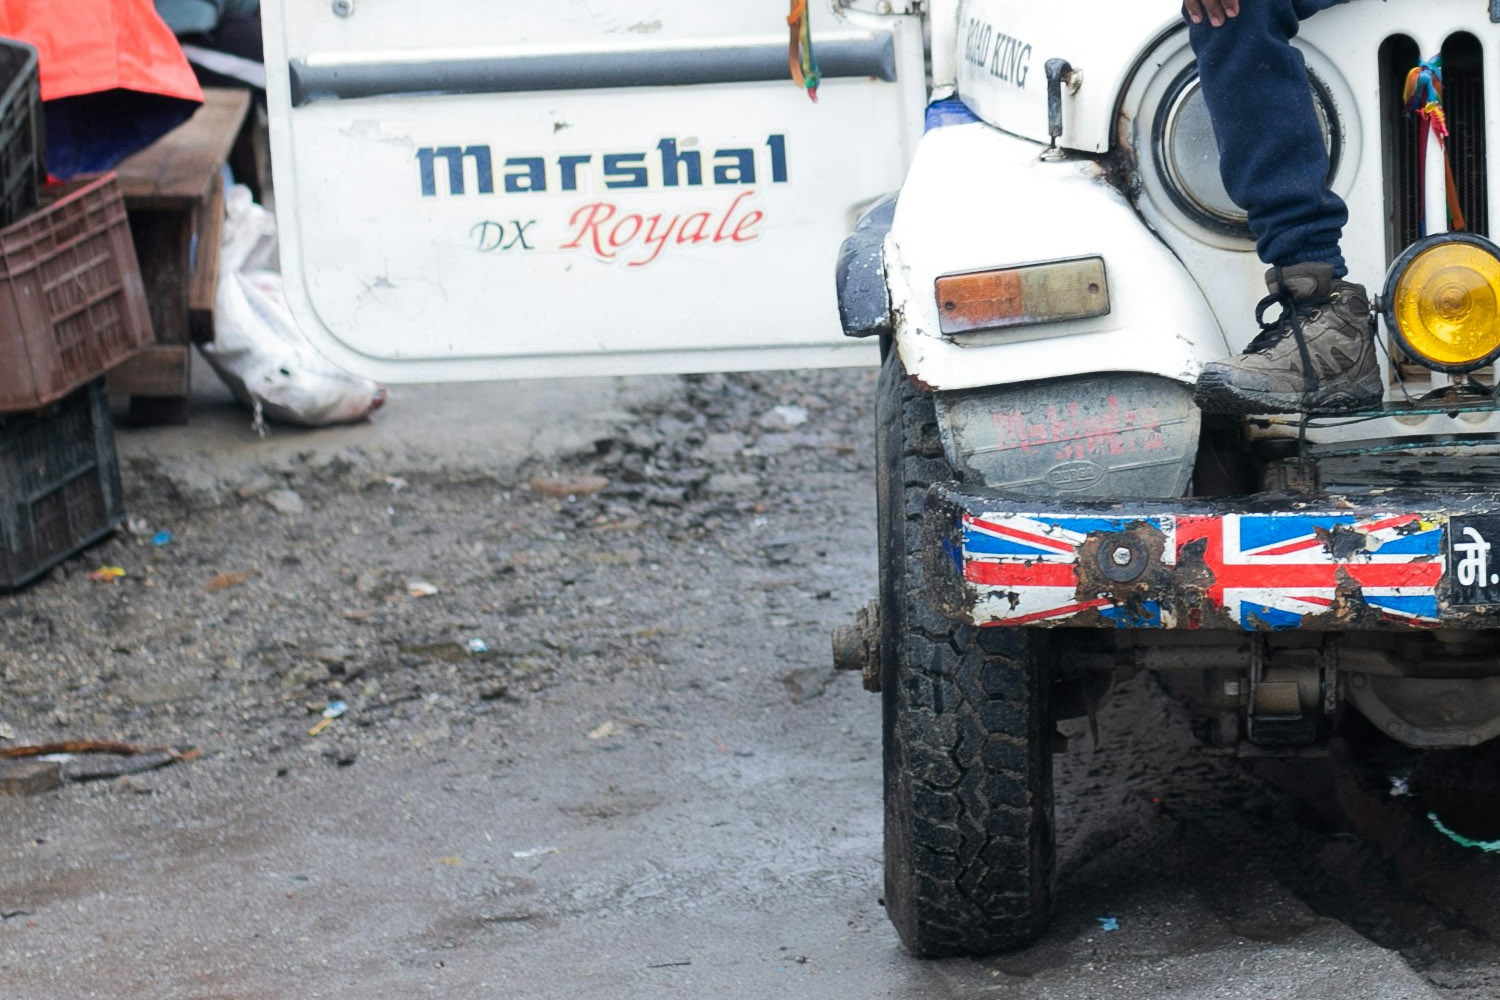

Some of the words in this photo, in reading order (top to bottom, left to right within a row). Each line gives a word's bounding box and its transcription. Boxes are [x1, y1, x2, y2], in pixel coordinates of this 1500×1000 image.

[990, 31, 1032, 89] KING
[415, 133, 788, 197] Marshal
[469, 218, 536, 252] DX
[560, 191, 764, 267] Royale
